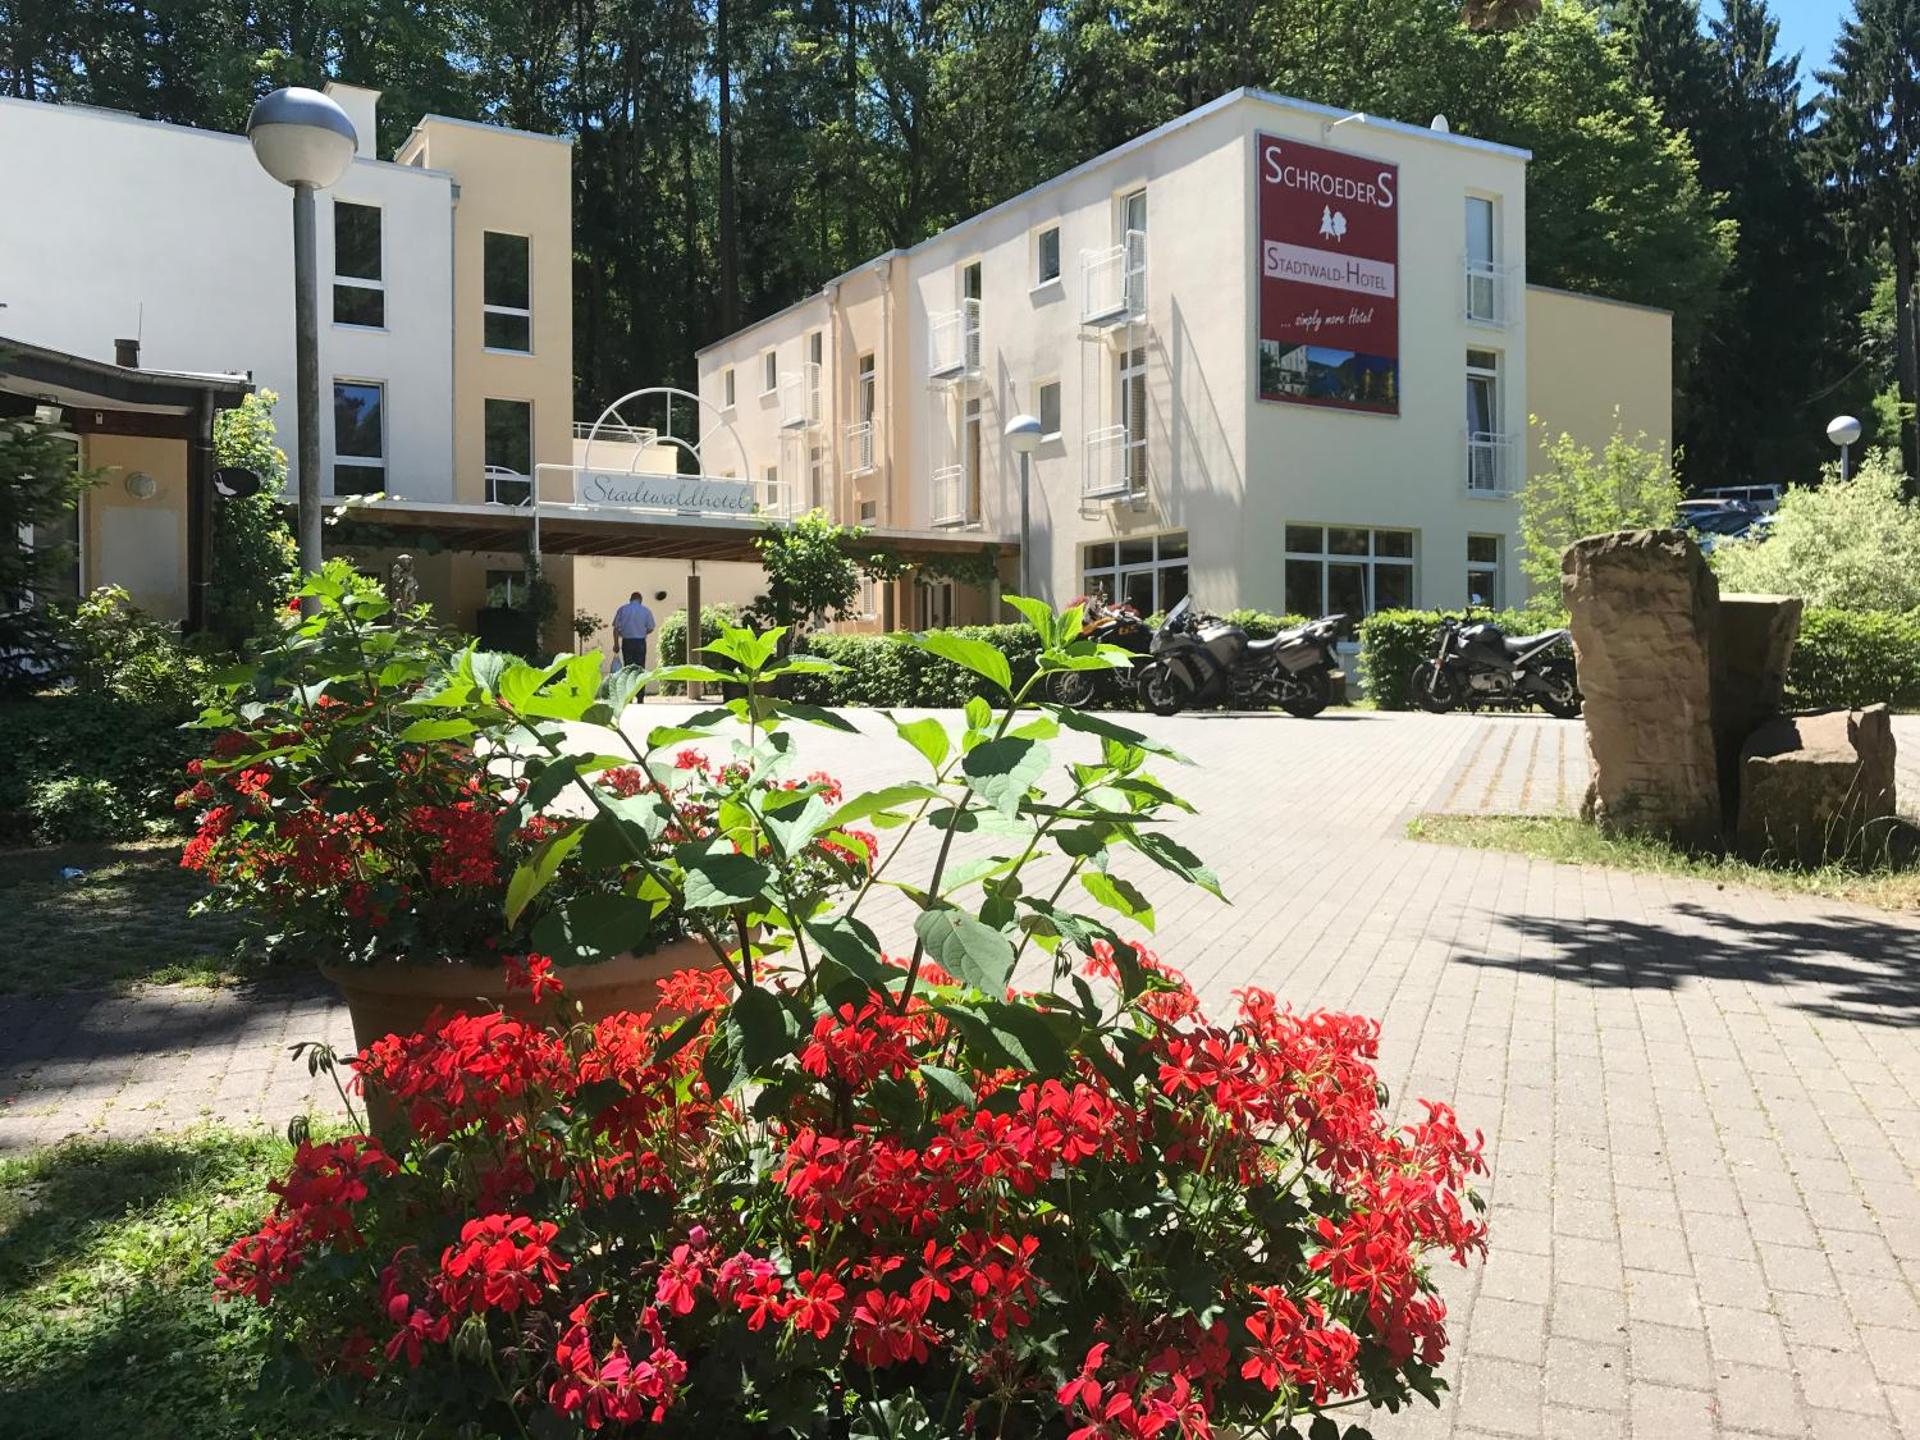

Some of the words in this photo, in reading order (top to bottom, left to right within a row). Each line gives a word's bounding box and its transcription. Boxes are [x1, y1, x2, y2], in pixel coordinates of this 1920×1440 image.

[1265, 145, 1394, 208] SCHROEDERS
[1267, 246, 1387, 291] STADTWALD-HOTEL
[1295, 308, 1322, 332] simply
[1325, 315, 1346, 326] more
[1348, 307, 1374, 325] Hotel
[583, 474, 749, 510] Stadtwaldhotel
